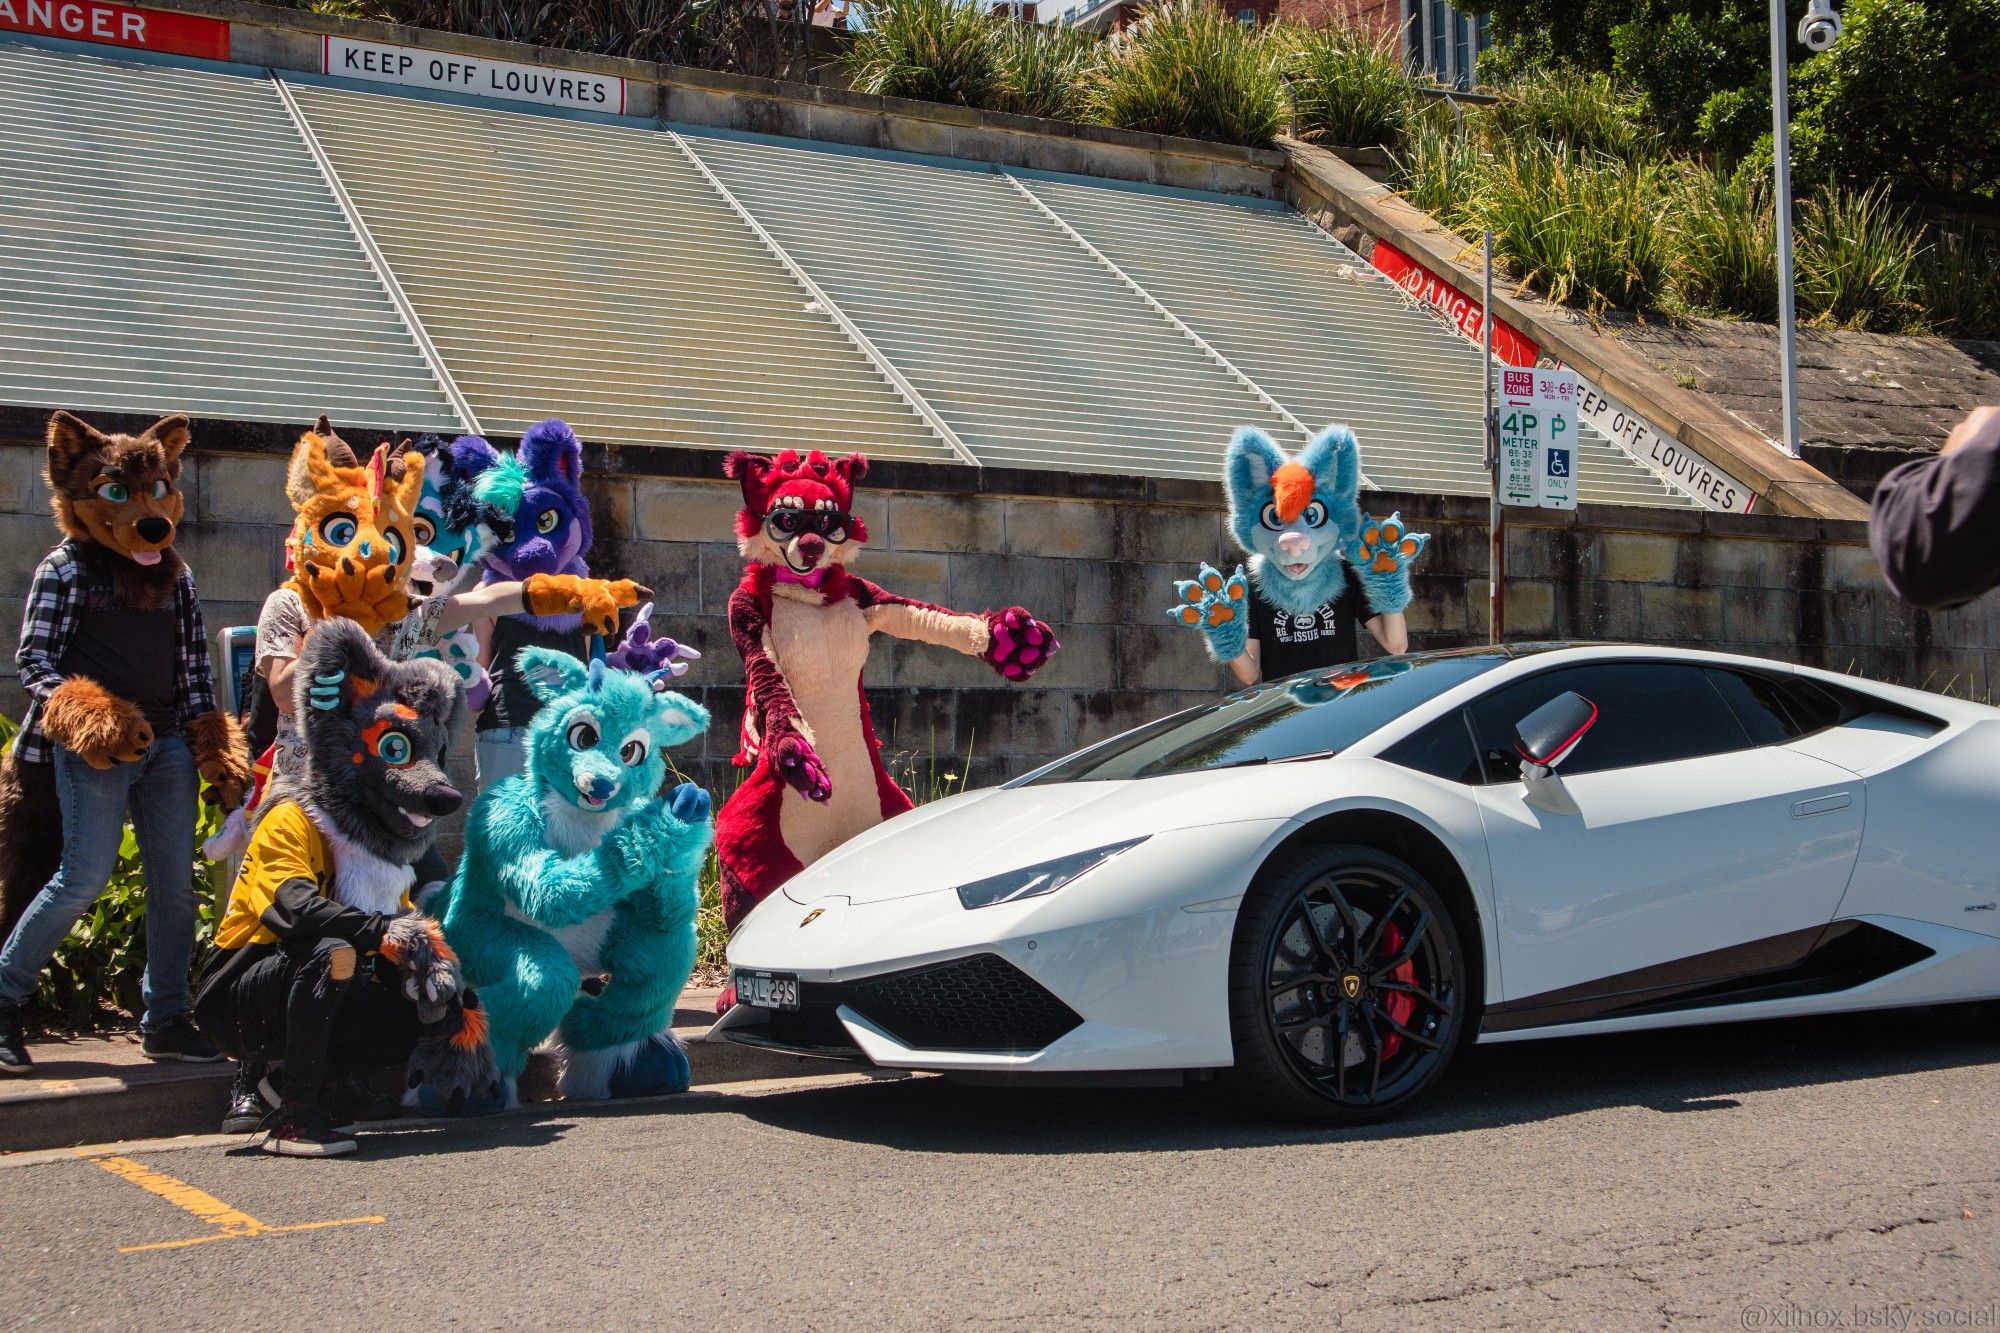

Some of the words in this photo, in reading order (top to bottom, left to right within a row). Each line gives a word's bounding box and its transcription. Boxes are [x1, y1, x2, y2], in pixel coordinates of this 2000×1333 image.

[345, 47, 413, 75] KEEP
[429, 60, 477, 85] OFF
[491, 69, 606, 104] LOUVRES
[1507, 373, 1530, 383] BUS
[1506, 384, 1532, 395] ZONE
[1502, 413, 1538, 437] 4P
[1551, 417, 1567, 440] P
[1502, 437, 1538, 450] METER
[1613, 412, 1648, 446] OFF
[1651, 438, 1736, 510] LOUVRES
[1547, 478, 1569, 489] ONLY
[1294, 629, 1319, 642] ISSUE
